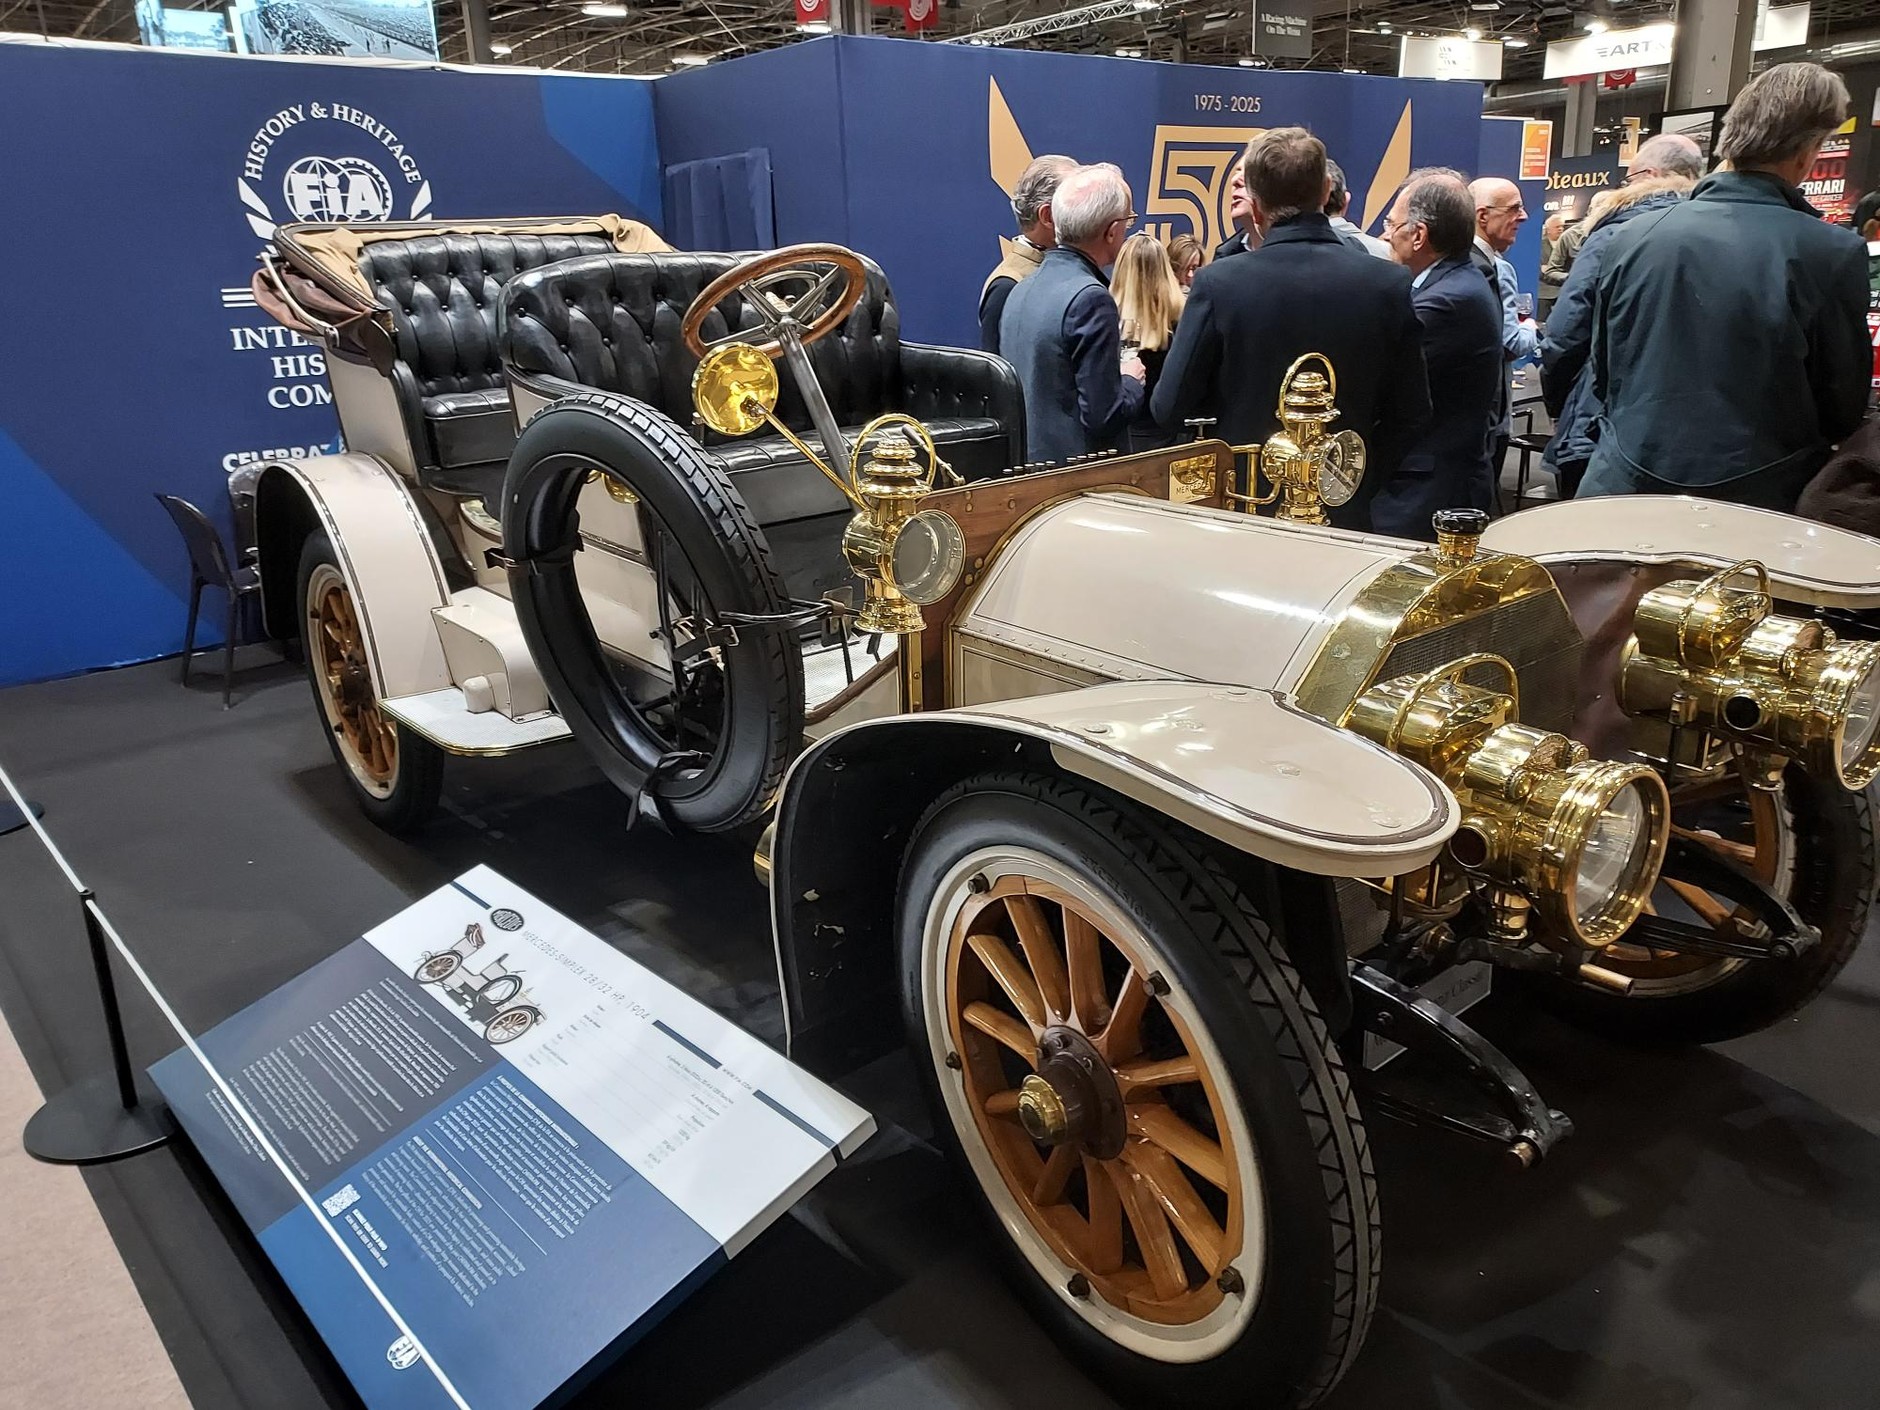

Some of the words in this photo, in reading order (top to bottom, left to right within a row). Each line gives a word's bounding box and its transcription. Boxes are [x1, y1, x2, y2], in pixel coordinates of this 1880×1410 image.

[1265, 24, 1276, 34] On
[1275, 25, 1287, 35] The
[1194, 94, 1222, 112] 1975
[1230, 95, 1262, 113] 2025
[244, 104, 307, 181] HISTORY
[310, 101, 329, 119] &
[331, 102, 422, 184] HERITAGE
[230, 326, 314, 351] INTE
[271, 353, 326, 379] HIS
[267, 383, 333, 409] COM
